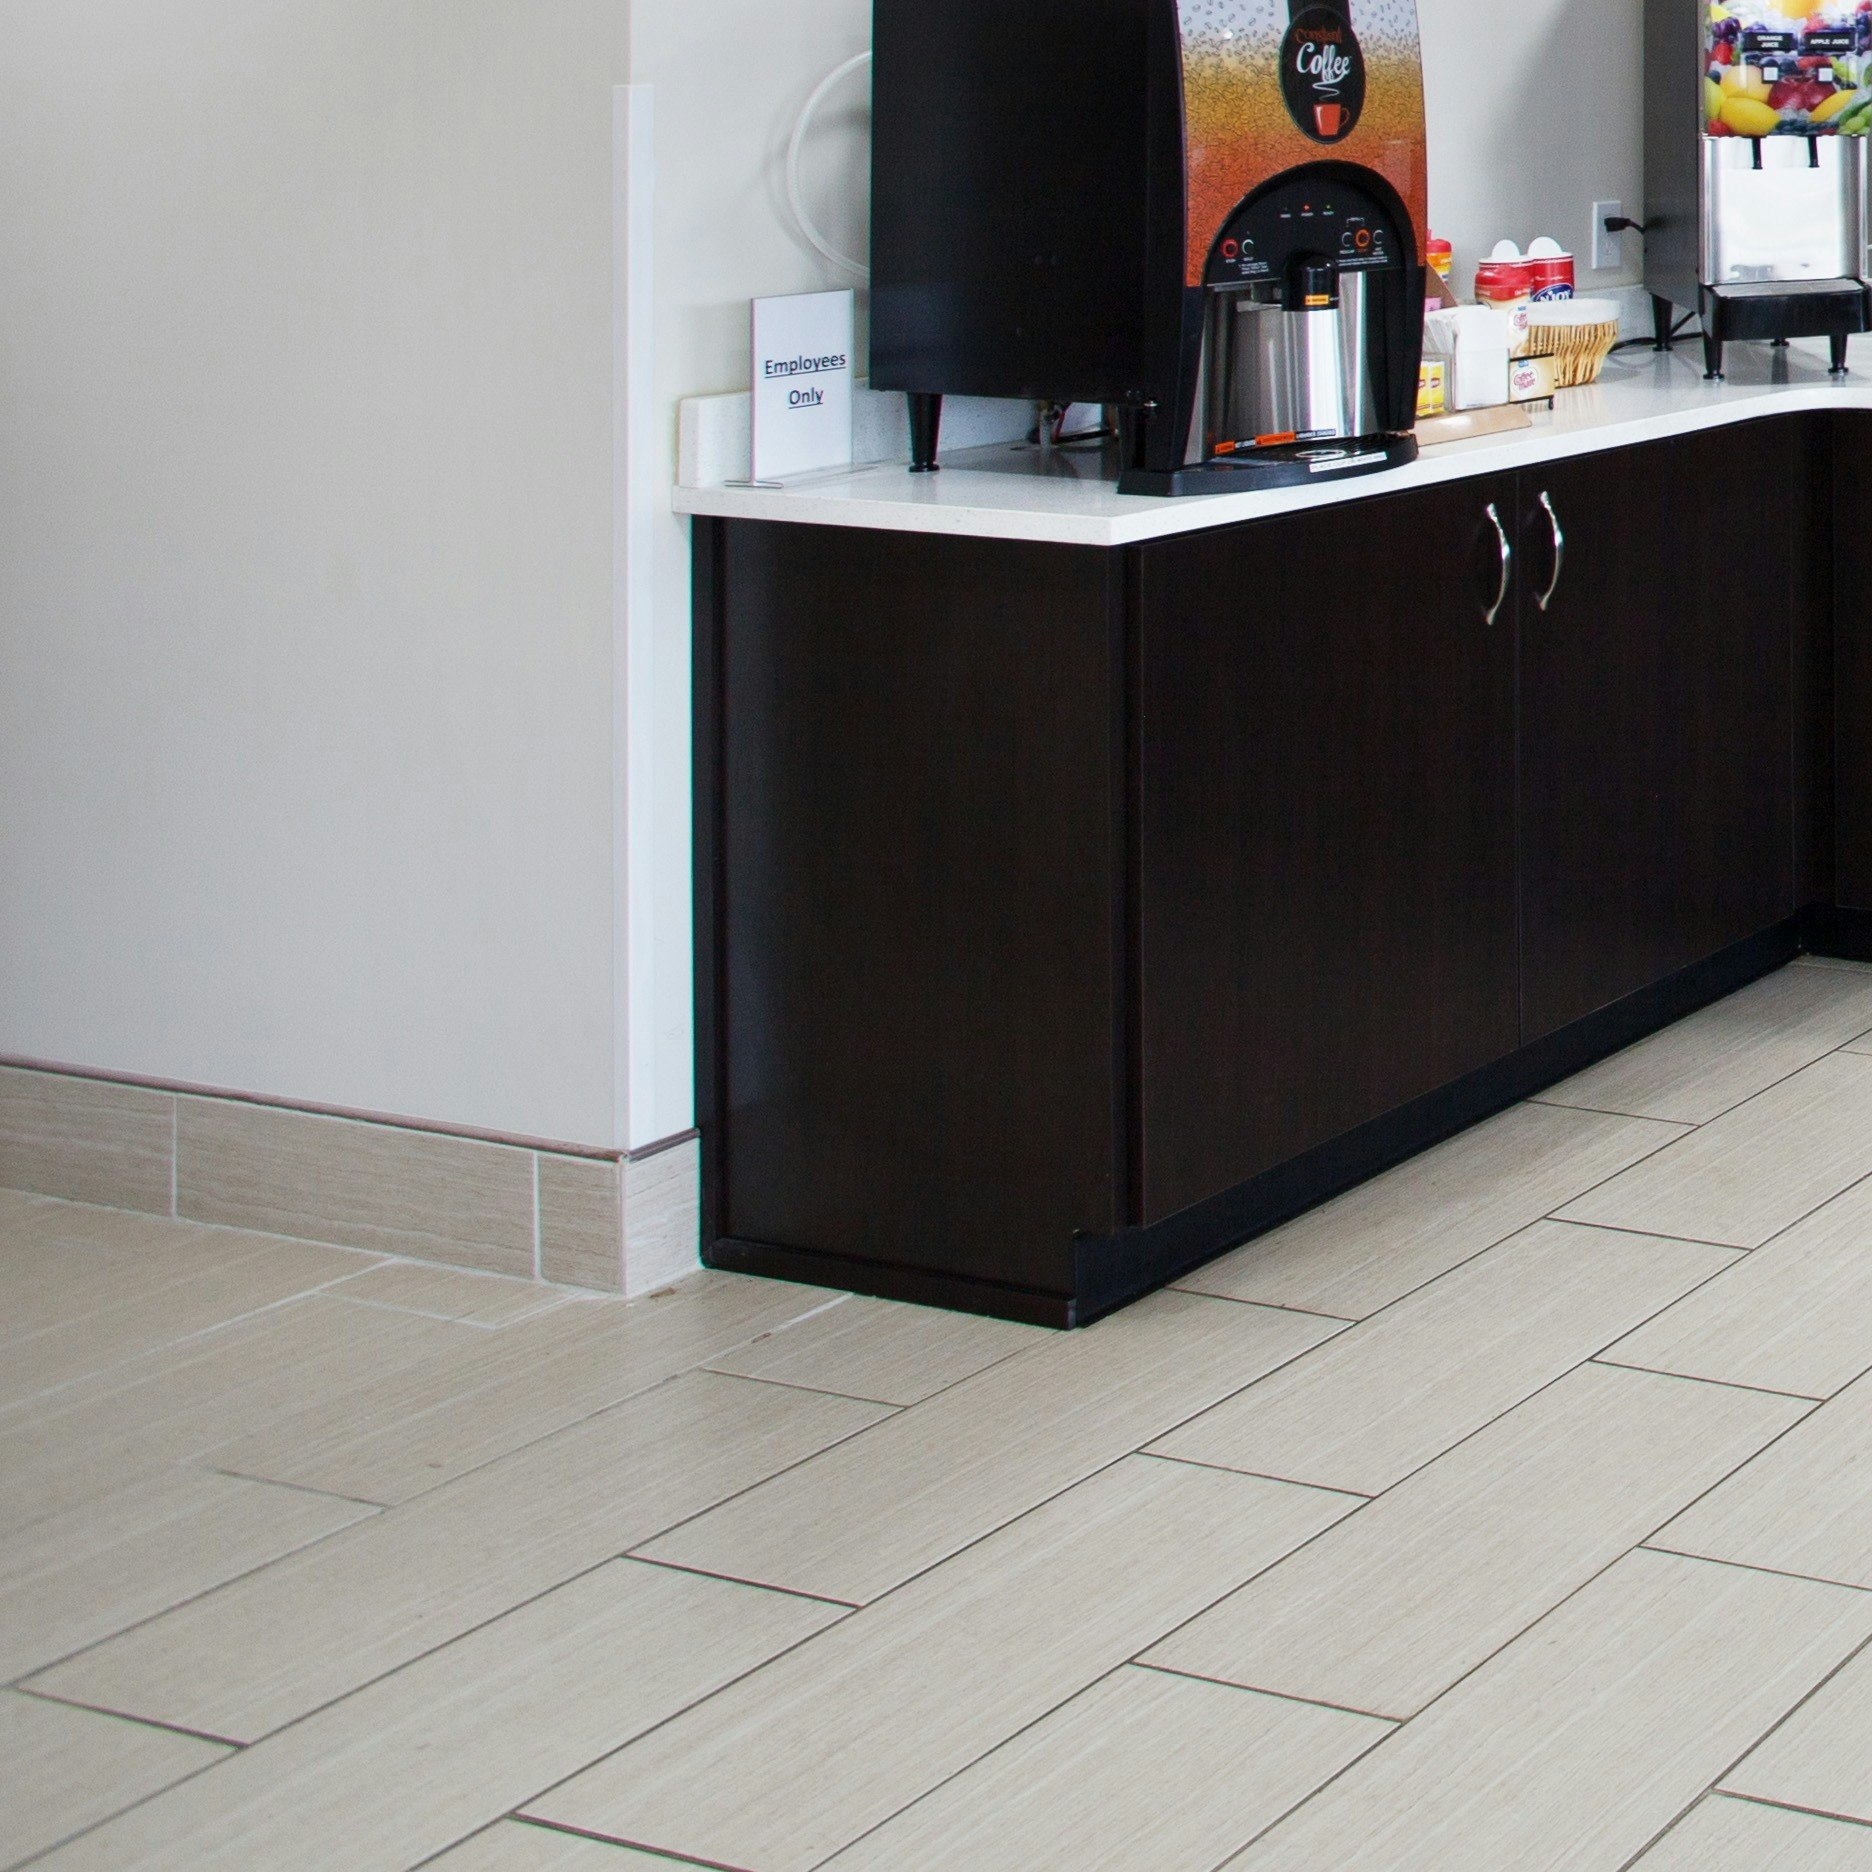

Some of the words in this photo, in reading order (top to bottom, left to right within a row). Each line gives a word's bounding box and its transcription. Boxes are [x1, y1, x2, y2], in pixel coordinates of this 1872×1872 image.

[1296, 42, 1351, 83] Coffee
[765, 354, 847, 376] Employees
[789, 387, 824, 405] Only
